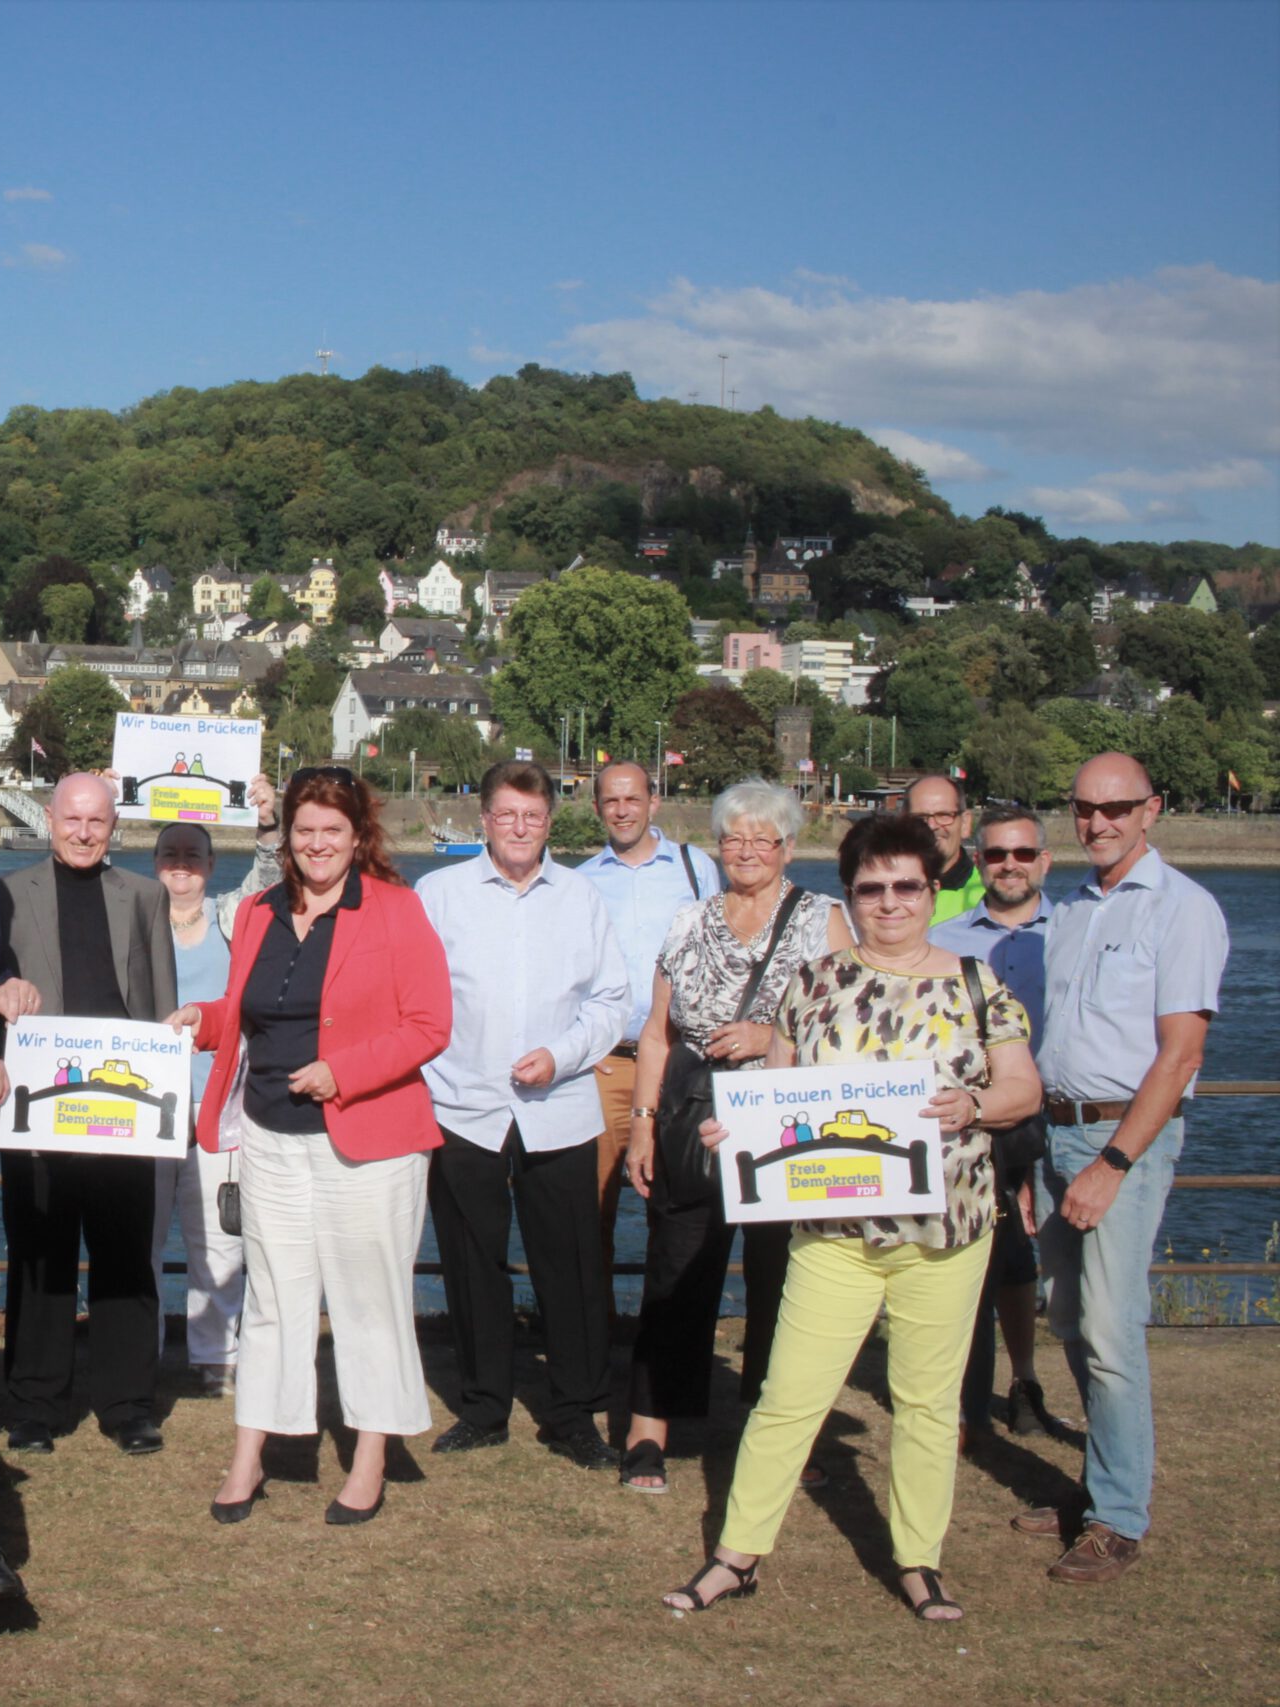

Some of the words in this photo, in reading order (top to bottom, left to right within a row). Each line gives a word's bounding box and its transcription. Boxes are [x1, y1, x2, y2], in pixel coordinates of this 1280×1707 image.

[121, 716, 144, 728] Wir
[151, 718, 190, 732] bauen
[198, 721, 257, 735] Brücken!
[153, 789, 179, 798] Freie
[153, 799, 218, 810] Demokraten
[17, 1033, 47, 1047] Wir
[54, 1034, 103, 1049] bauen
[111, 1036, 182, 1055] Brücken!
[727, 1090, 764, 1107] Wir
[774, 1088, 831, 1104] bauen
[841, 1079, 926, 1100] Brücken!
[58, 1101, 89, 1112] Freie
[57, 1113, 134, 1126] Demokraten
[112, 1128, 131, 1136] FDP
[789, 1164, 826, 1175] Freie
[790, 1174, 880, 1189] Demokraten
[856, 1187, 877, 1195] FDP
